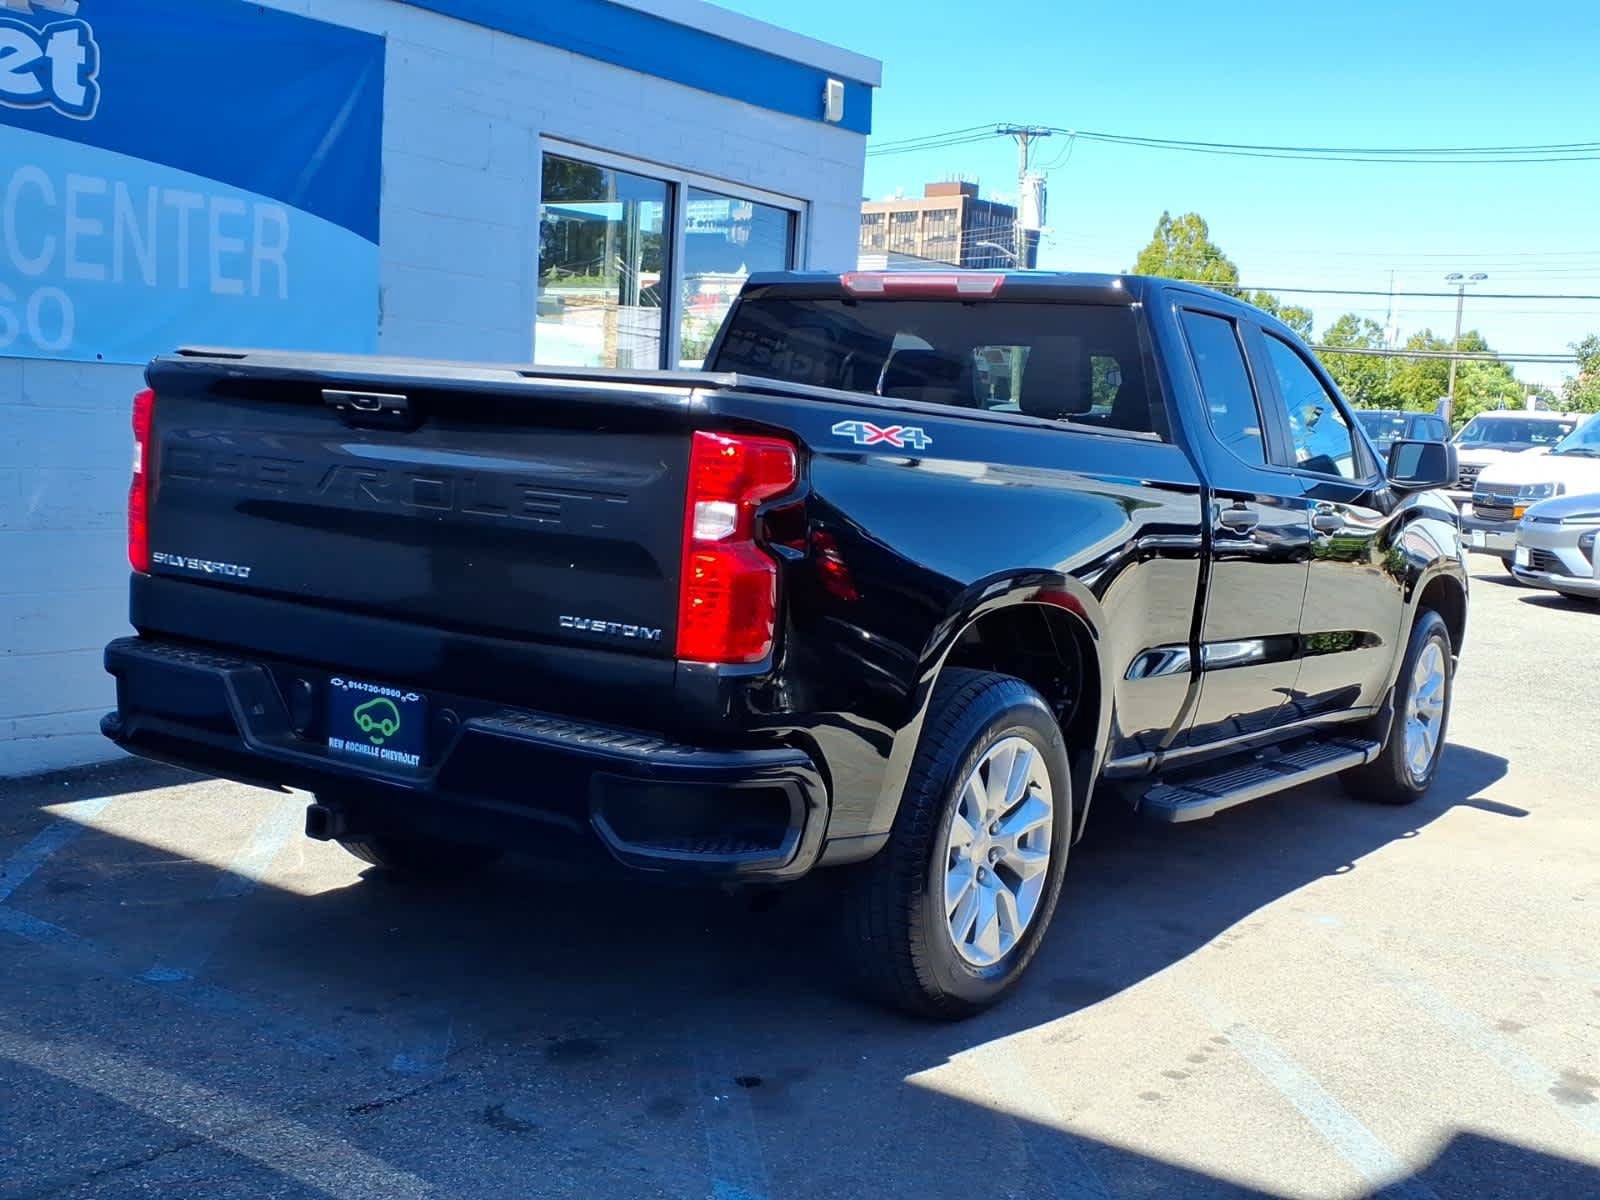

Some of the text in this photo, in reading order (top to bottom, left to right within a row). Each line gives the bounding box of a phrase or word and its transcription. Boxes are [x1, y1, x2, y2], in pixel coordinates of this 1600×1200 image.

[4, 165, 290, 299] CENTER
[153, 552, 250, 578] SILVERADO
[559, 615, 662, 641] CUSTOM
[329, 738, 420, 767] NEW ROCHELLE CHEVROLET
